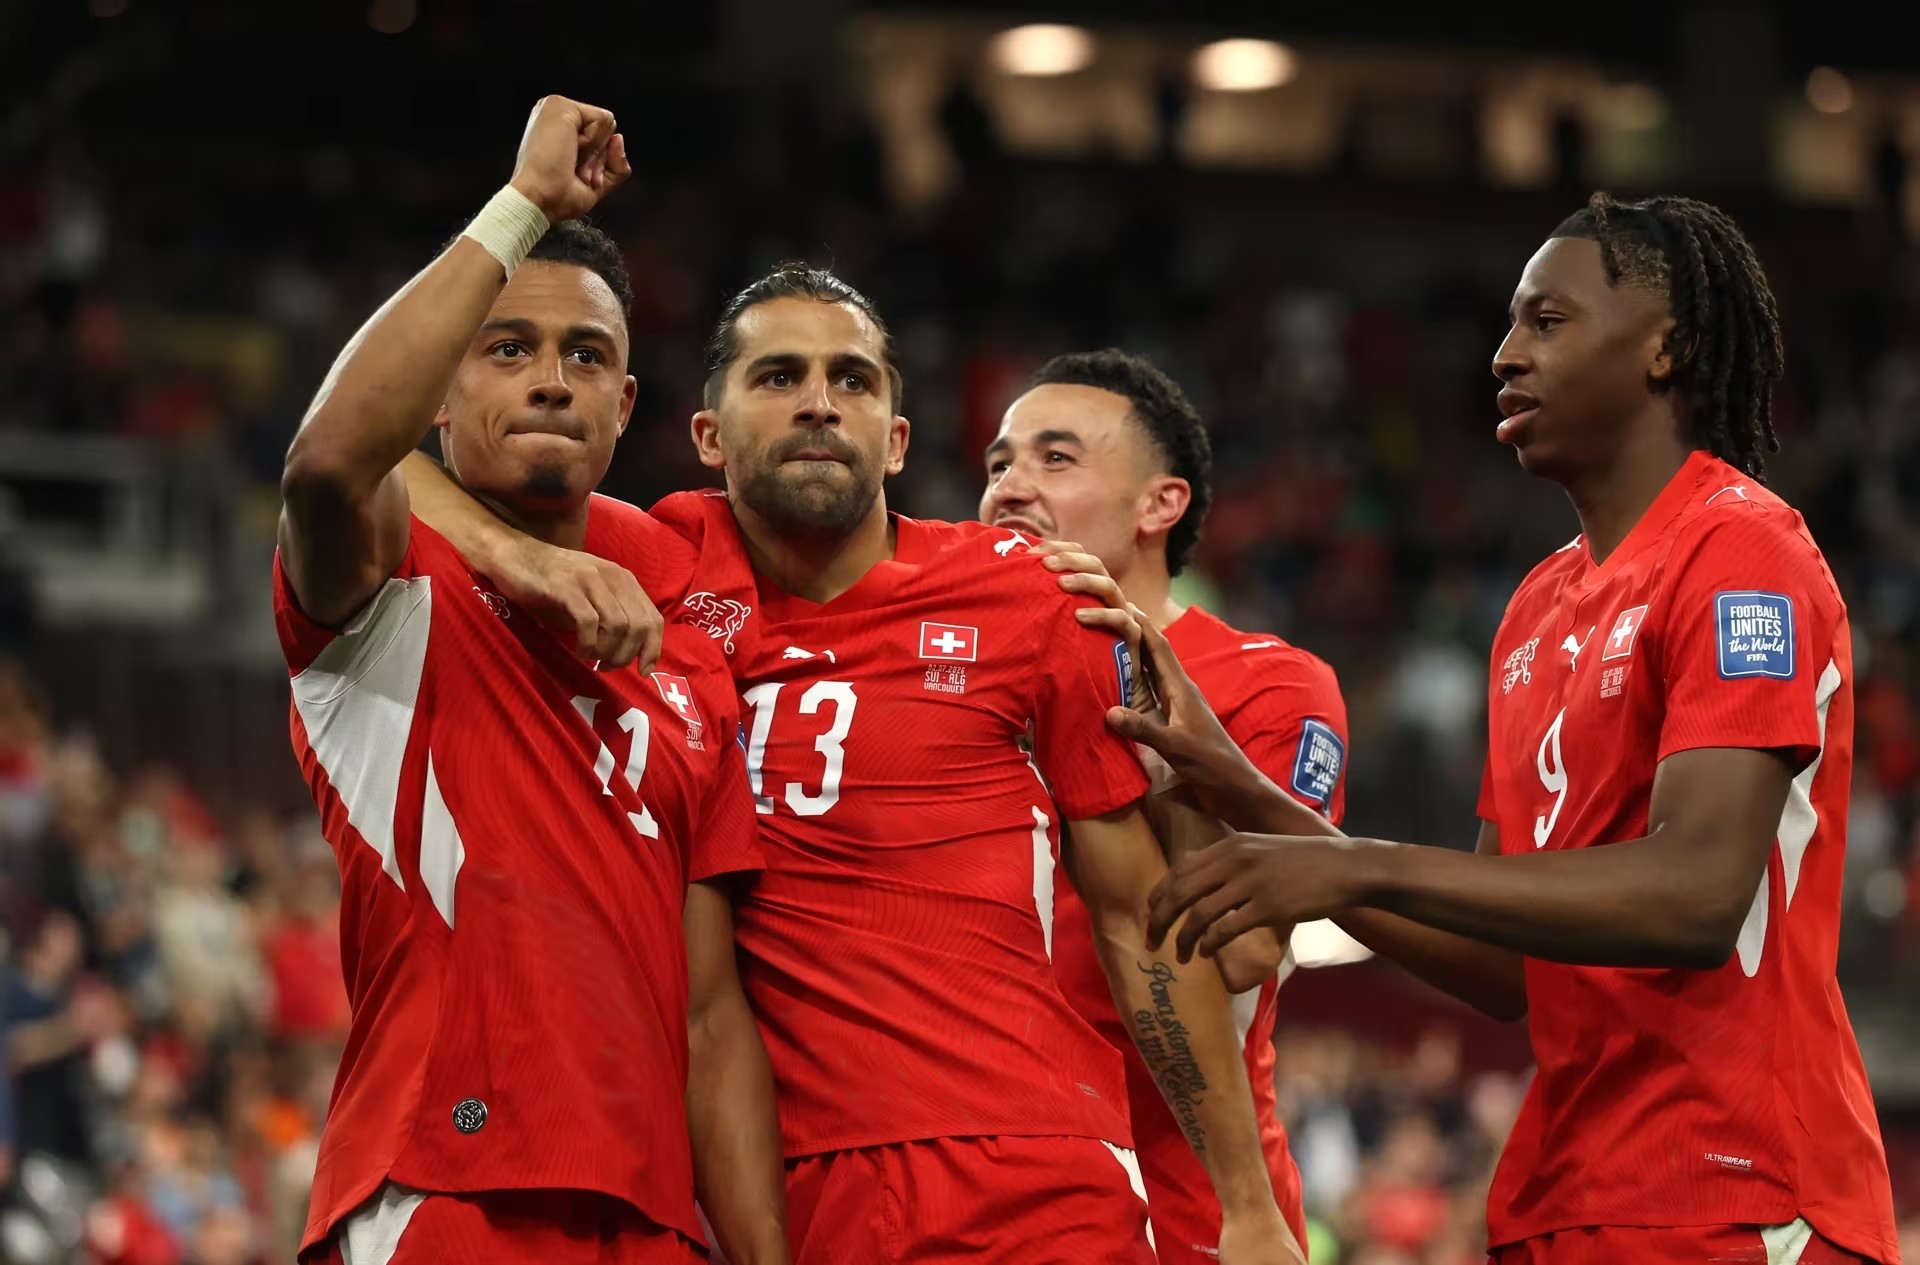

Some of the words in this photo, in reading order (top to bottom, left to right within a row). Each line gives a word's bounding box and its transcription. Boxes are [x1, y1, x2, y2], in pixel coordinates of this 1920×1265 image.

[1730, 605, 1782, 619] FOOTBALL
[1730, 618, 1782, 637] UNITES
[1728, 637, 1750, 653] the
[1751, 637, 1785, 655] World
[1746, 653, 1769, 662] FIFA
[928, 664, 965, 674] 02.07.2026
[924, 671, 939, 682] SUI
[949, 673, 966, 685] ALG
[923, 682, 964, 693] VANCOUVER
[742, 680, 858, 816] 13
[1533, 705, 1568, 849] 9
[1704, 1152, 1752, 1168] ULTRAWEAVE
